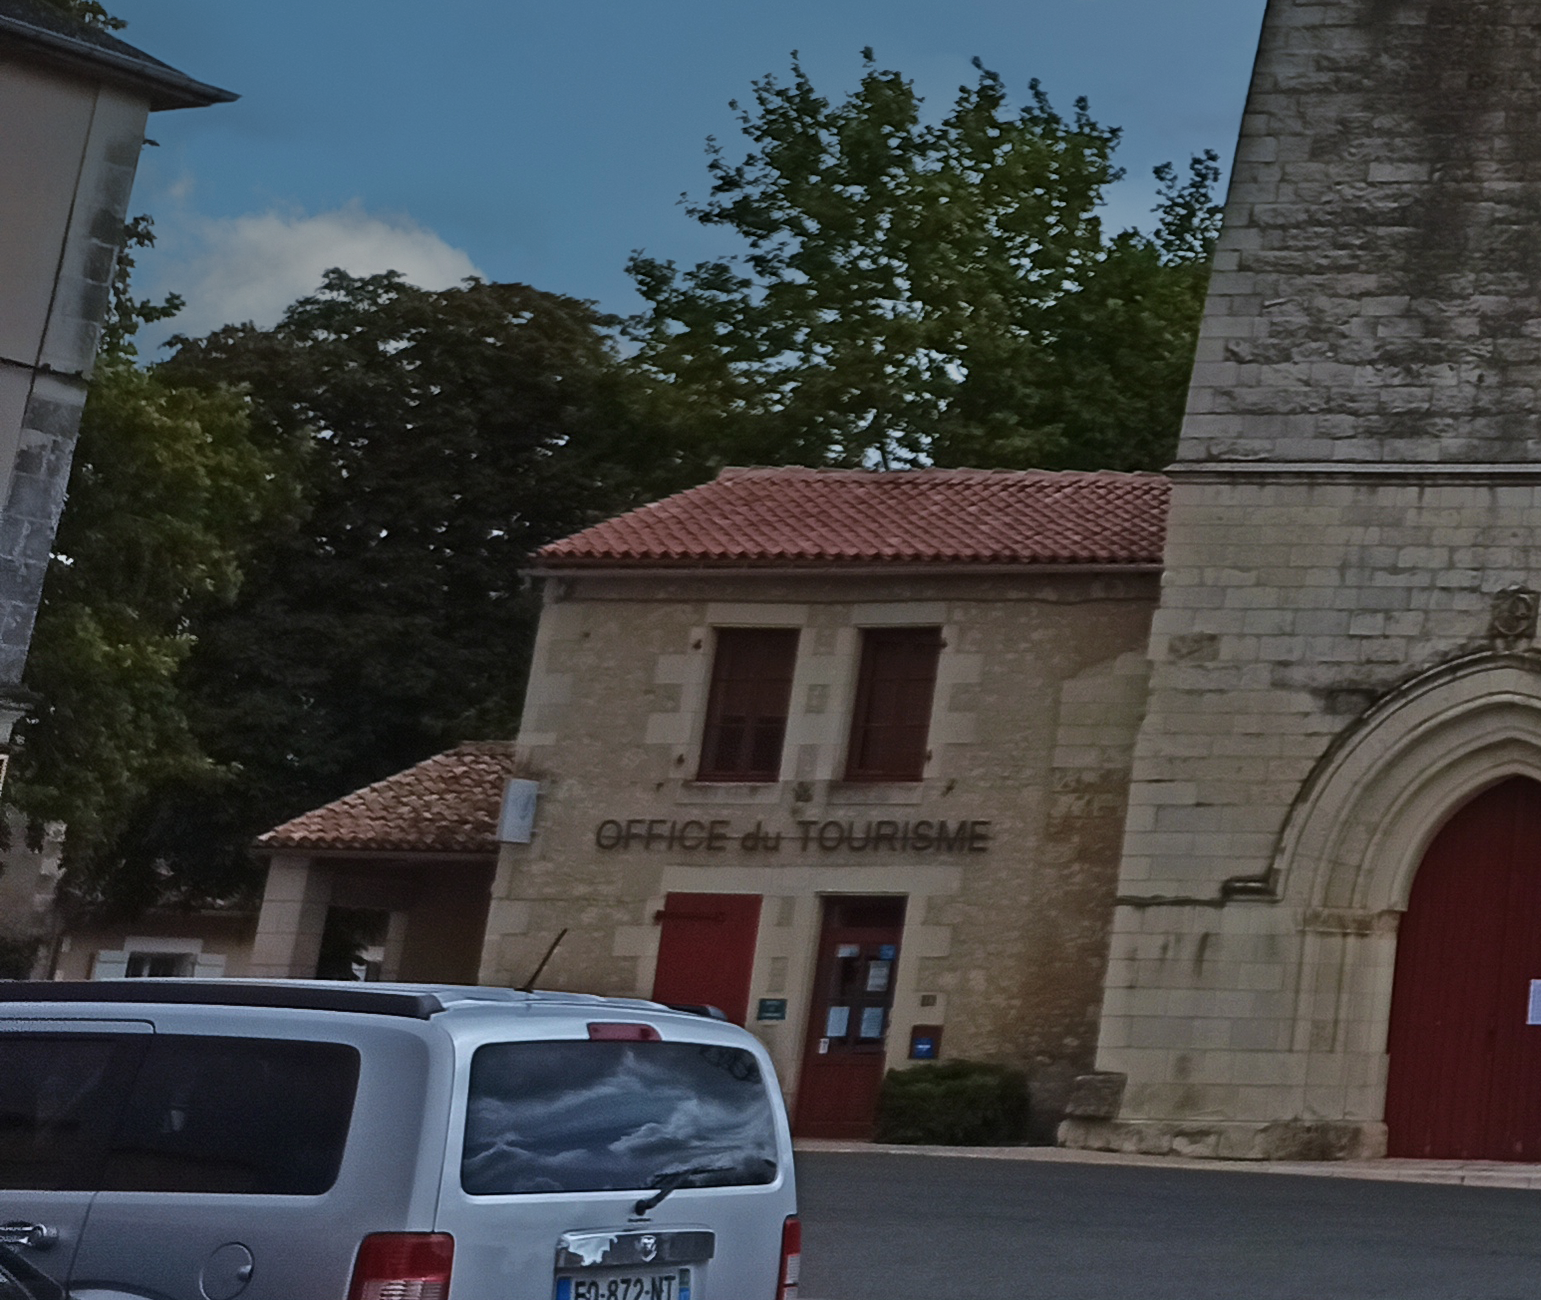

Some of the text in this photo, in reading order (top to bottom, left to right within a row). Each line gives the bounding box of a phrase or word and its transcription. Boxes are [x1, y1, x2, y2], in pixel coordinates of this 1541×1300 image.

[595, 819, 992, 852] OFFICE du TOURISME
